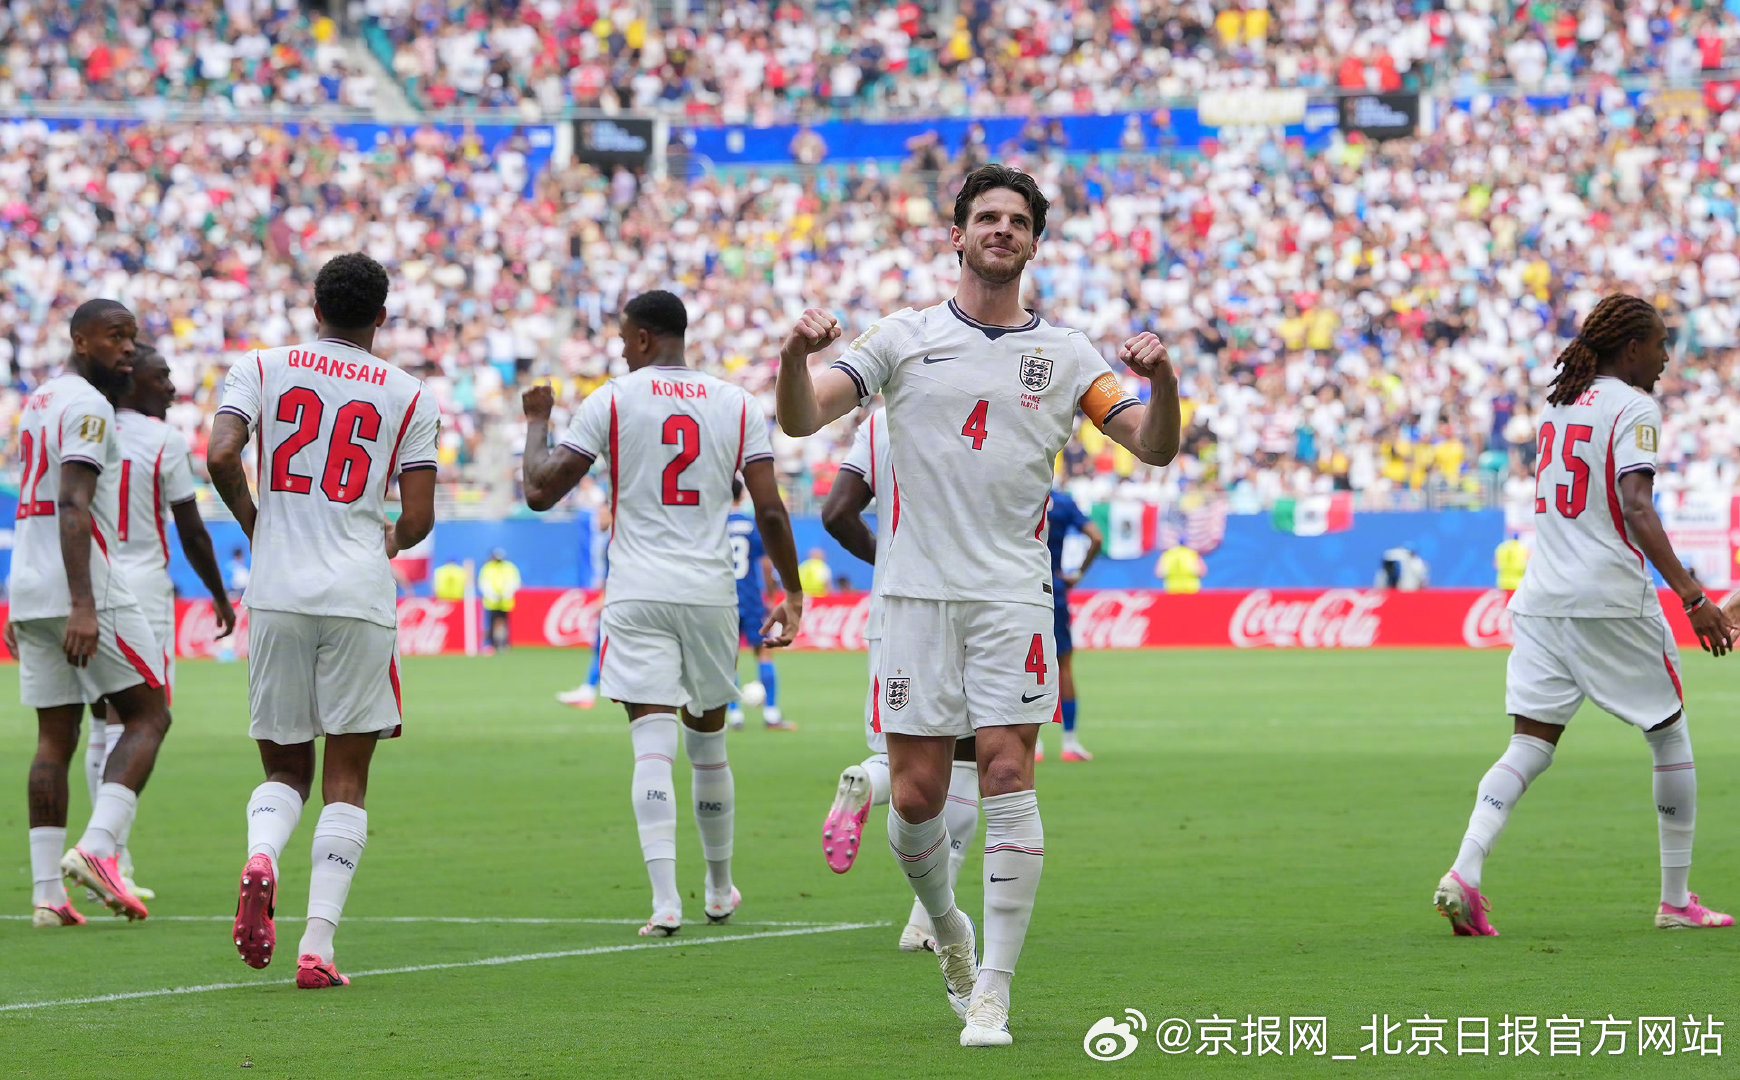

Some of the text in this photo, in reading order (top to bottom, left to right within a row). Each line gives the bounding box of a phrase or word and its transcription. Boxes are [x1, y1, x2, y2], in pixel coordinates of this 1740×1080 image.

[288, 350, 387, 386] QUANSAH
[652, 380, 707, 399] KONSA
[1020, 393, 1041, 404] FRANCE
[961, 400, 989, 450] 4
[271, 386, 382, 504] 26
[16, 426, 55, 519] 22
[662, 414, 700, 506] 2
[1535, 421, 1593, 519] 25
[1228, 588, 1386, 648] Coca-Cola
[1025, 634, 1047, 685] 4
[646, 790, 667, 801] ENG
[698, 801, 722, 811] ENG
[1483, 795, 1503, 810] ENG
[252, 806, 276, 816] ENG
[1658, 805, 1676, 815] ENG
[327, 853, 354, 869] ENG
